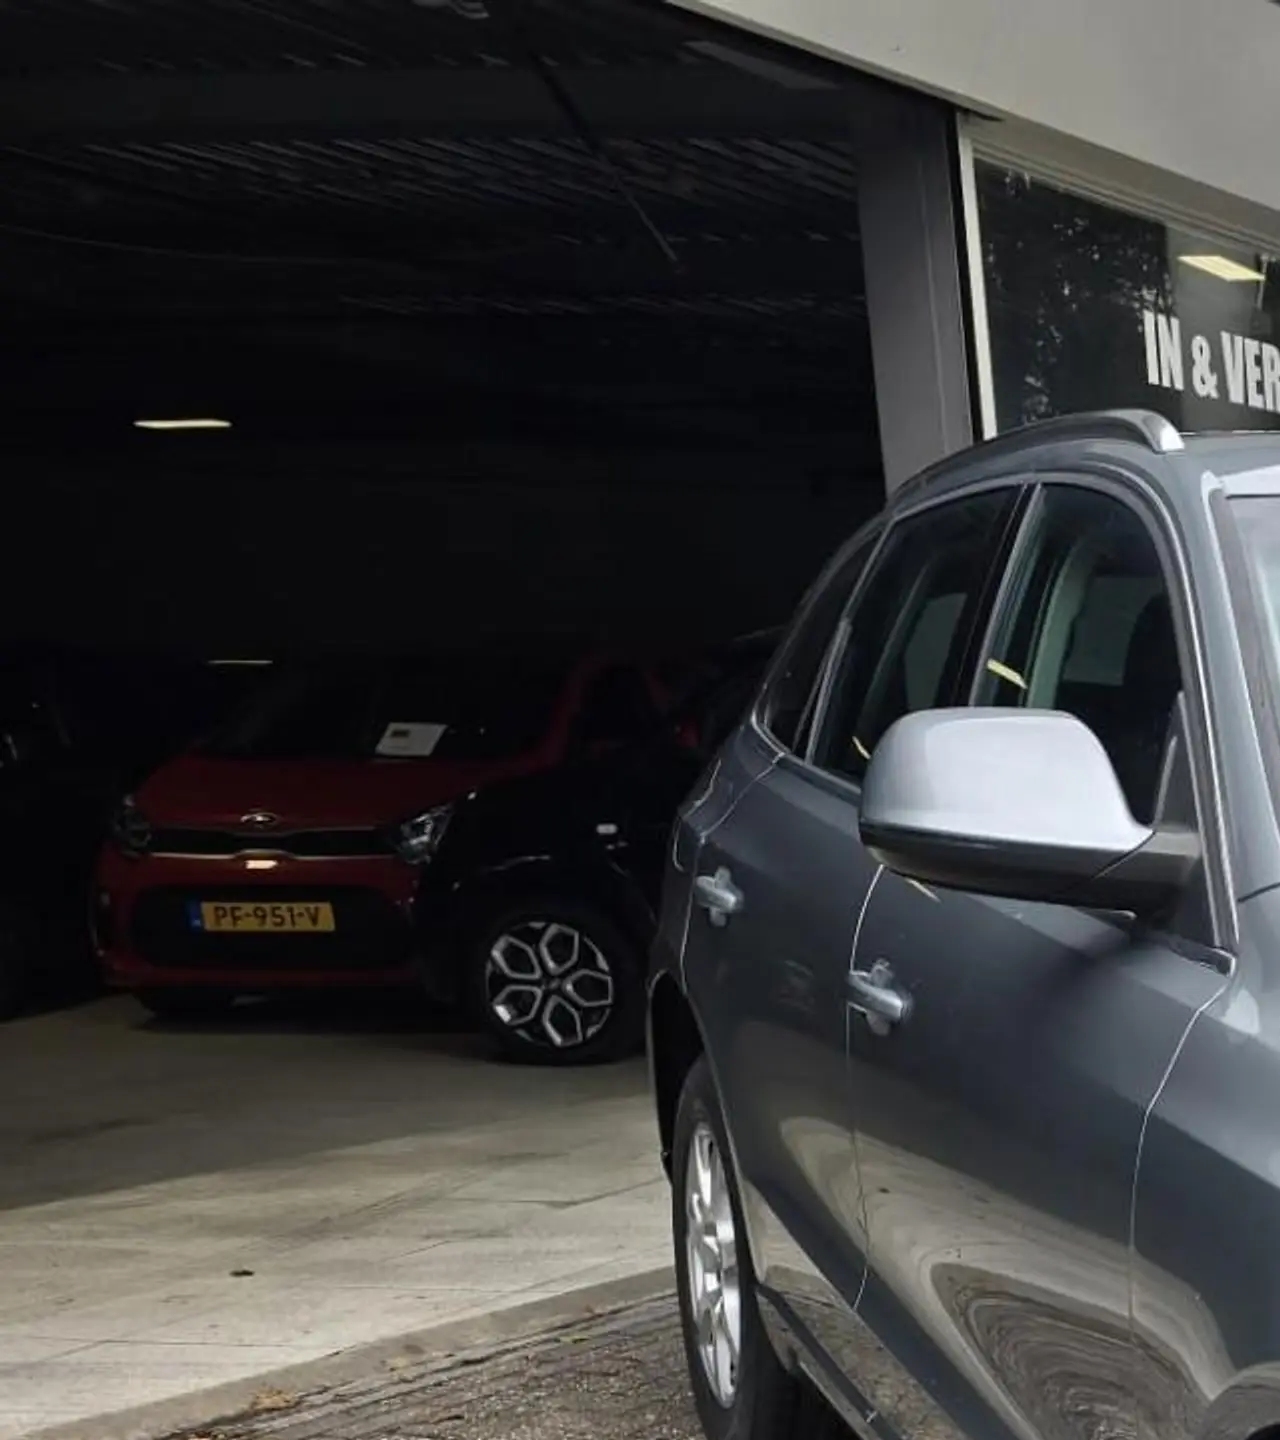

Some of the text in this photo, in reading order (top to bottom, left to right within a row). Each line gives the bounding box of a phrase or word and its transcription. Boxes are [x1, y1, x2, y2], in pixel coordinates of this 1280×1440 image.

[1143, 309, 1184, 391] IN
[1191, 335, 1219, 399] &
[213, 906, 320, 928] PF-951-V
